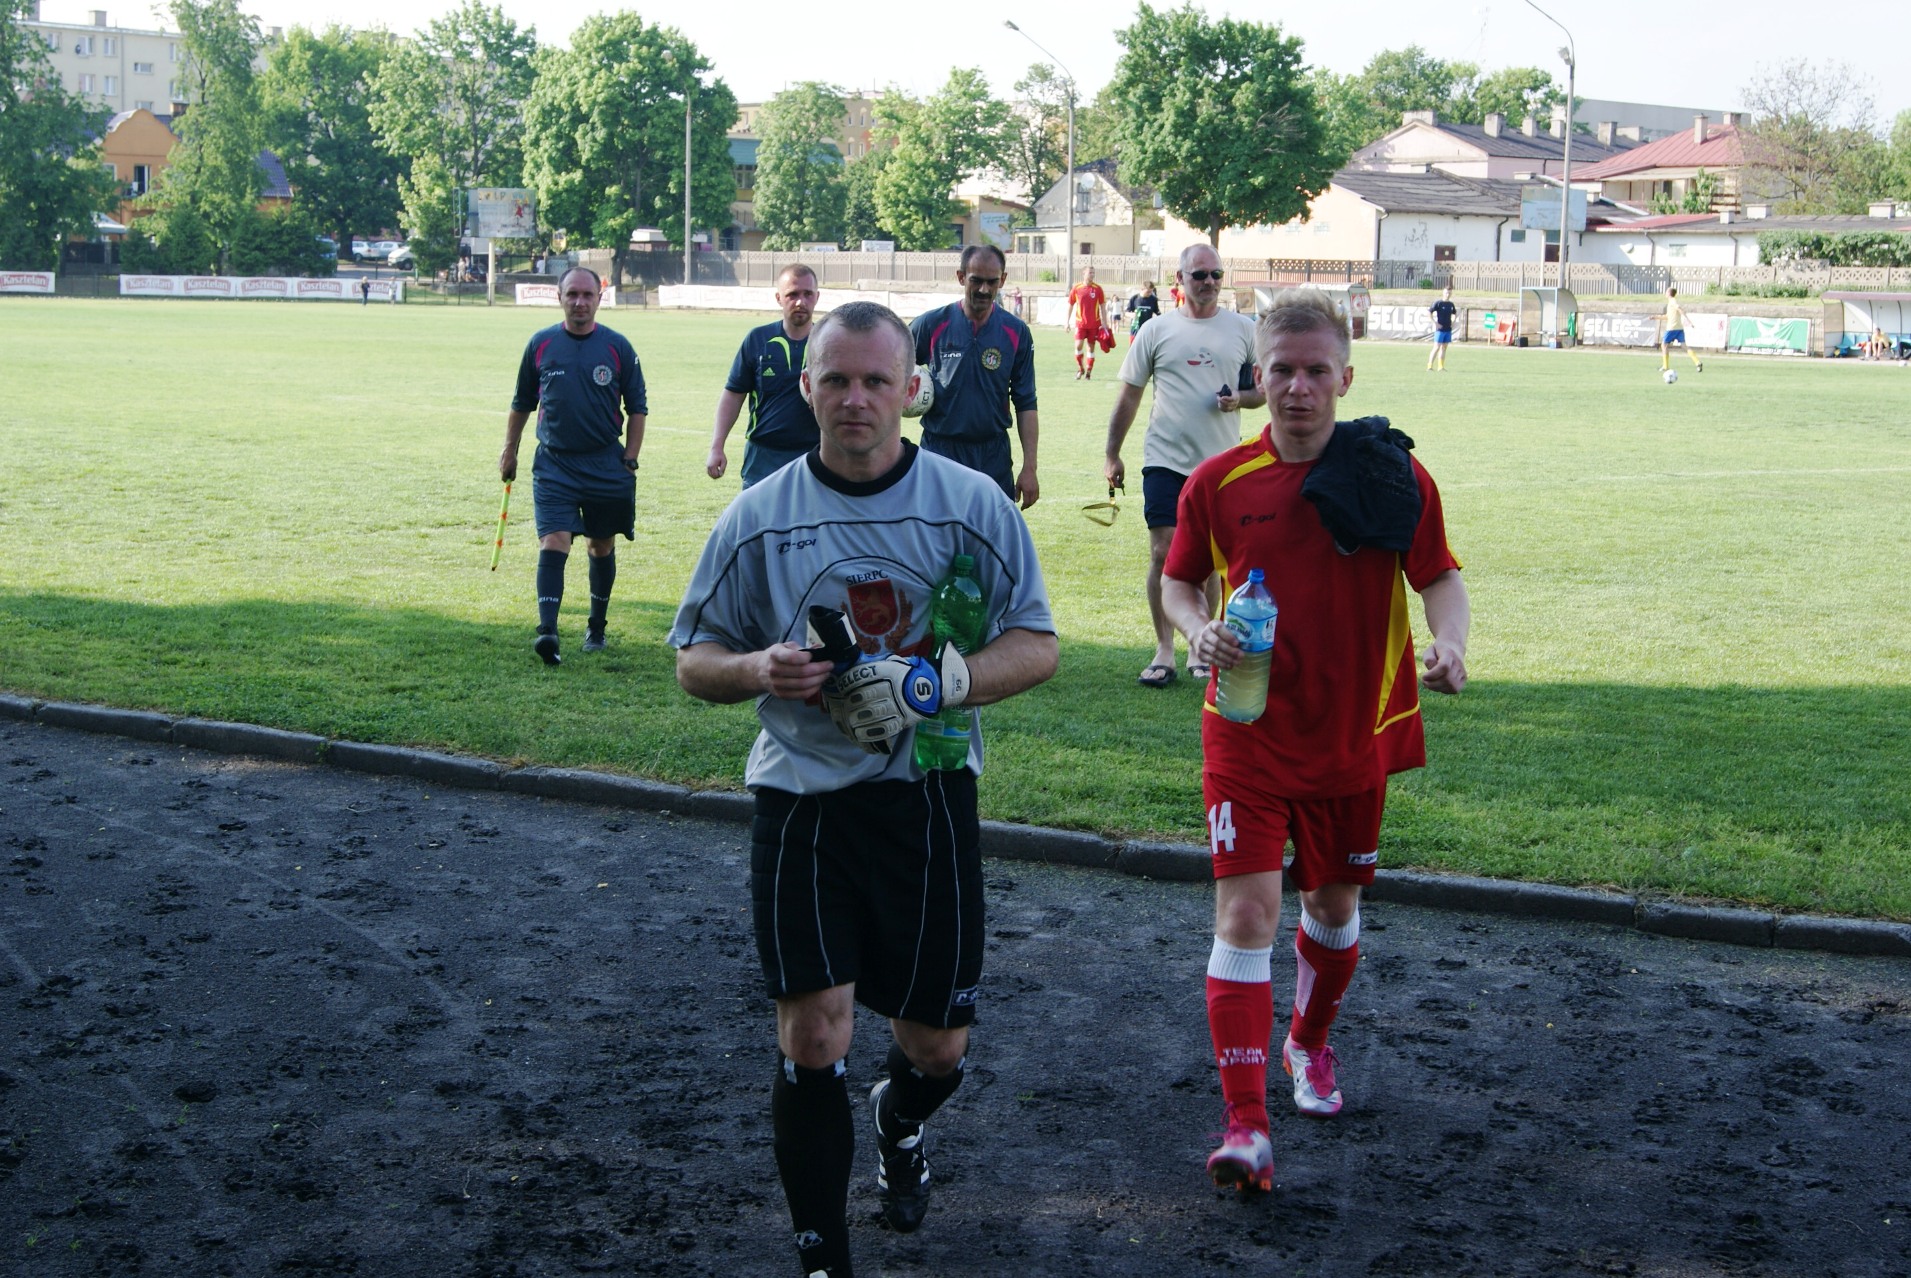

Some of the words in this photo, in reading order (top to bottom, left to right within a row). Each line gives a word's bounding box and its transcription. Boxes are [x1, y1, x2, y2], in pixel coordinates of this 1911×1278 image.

[244, 279, 285, 290] Kasztelan
[300, 280, 341, 291] Kasztelan
[1368, 306, 1432, 332] SELEC
[1584, 318, 1641, 338] SELECT
[845, 569, 888, 586] SIERPC
[837, 665, 878, 692] SELECT
[1208, 801, 1237, 855] 14
[1219, 1055, 1266, 1067] SPORT
